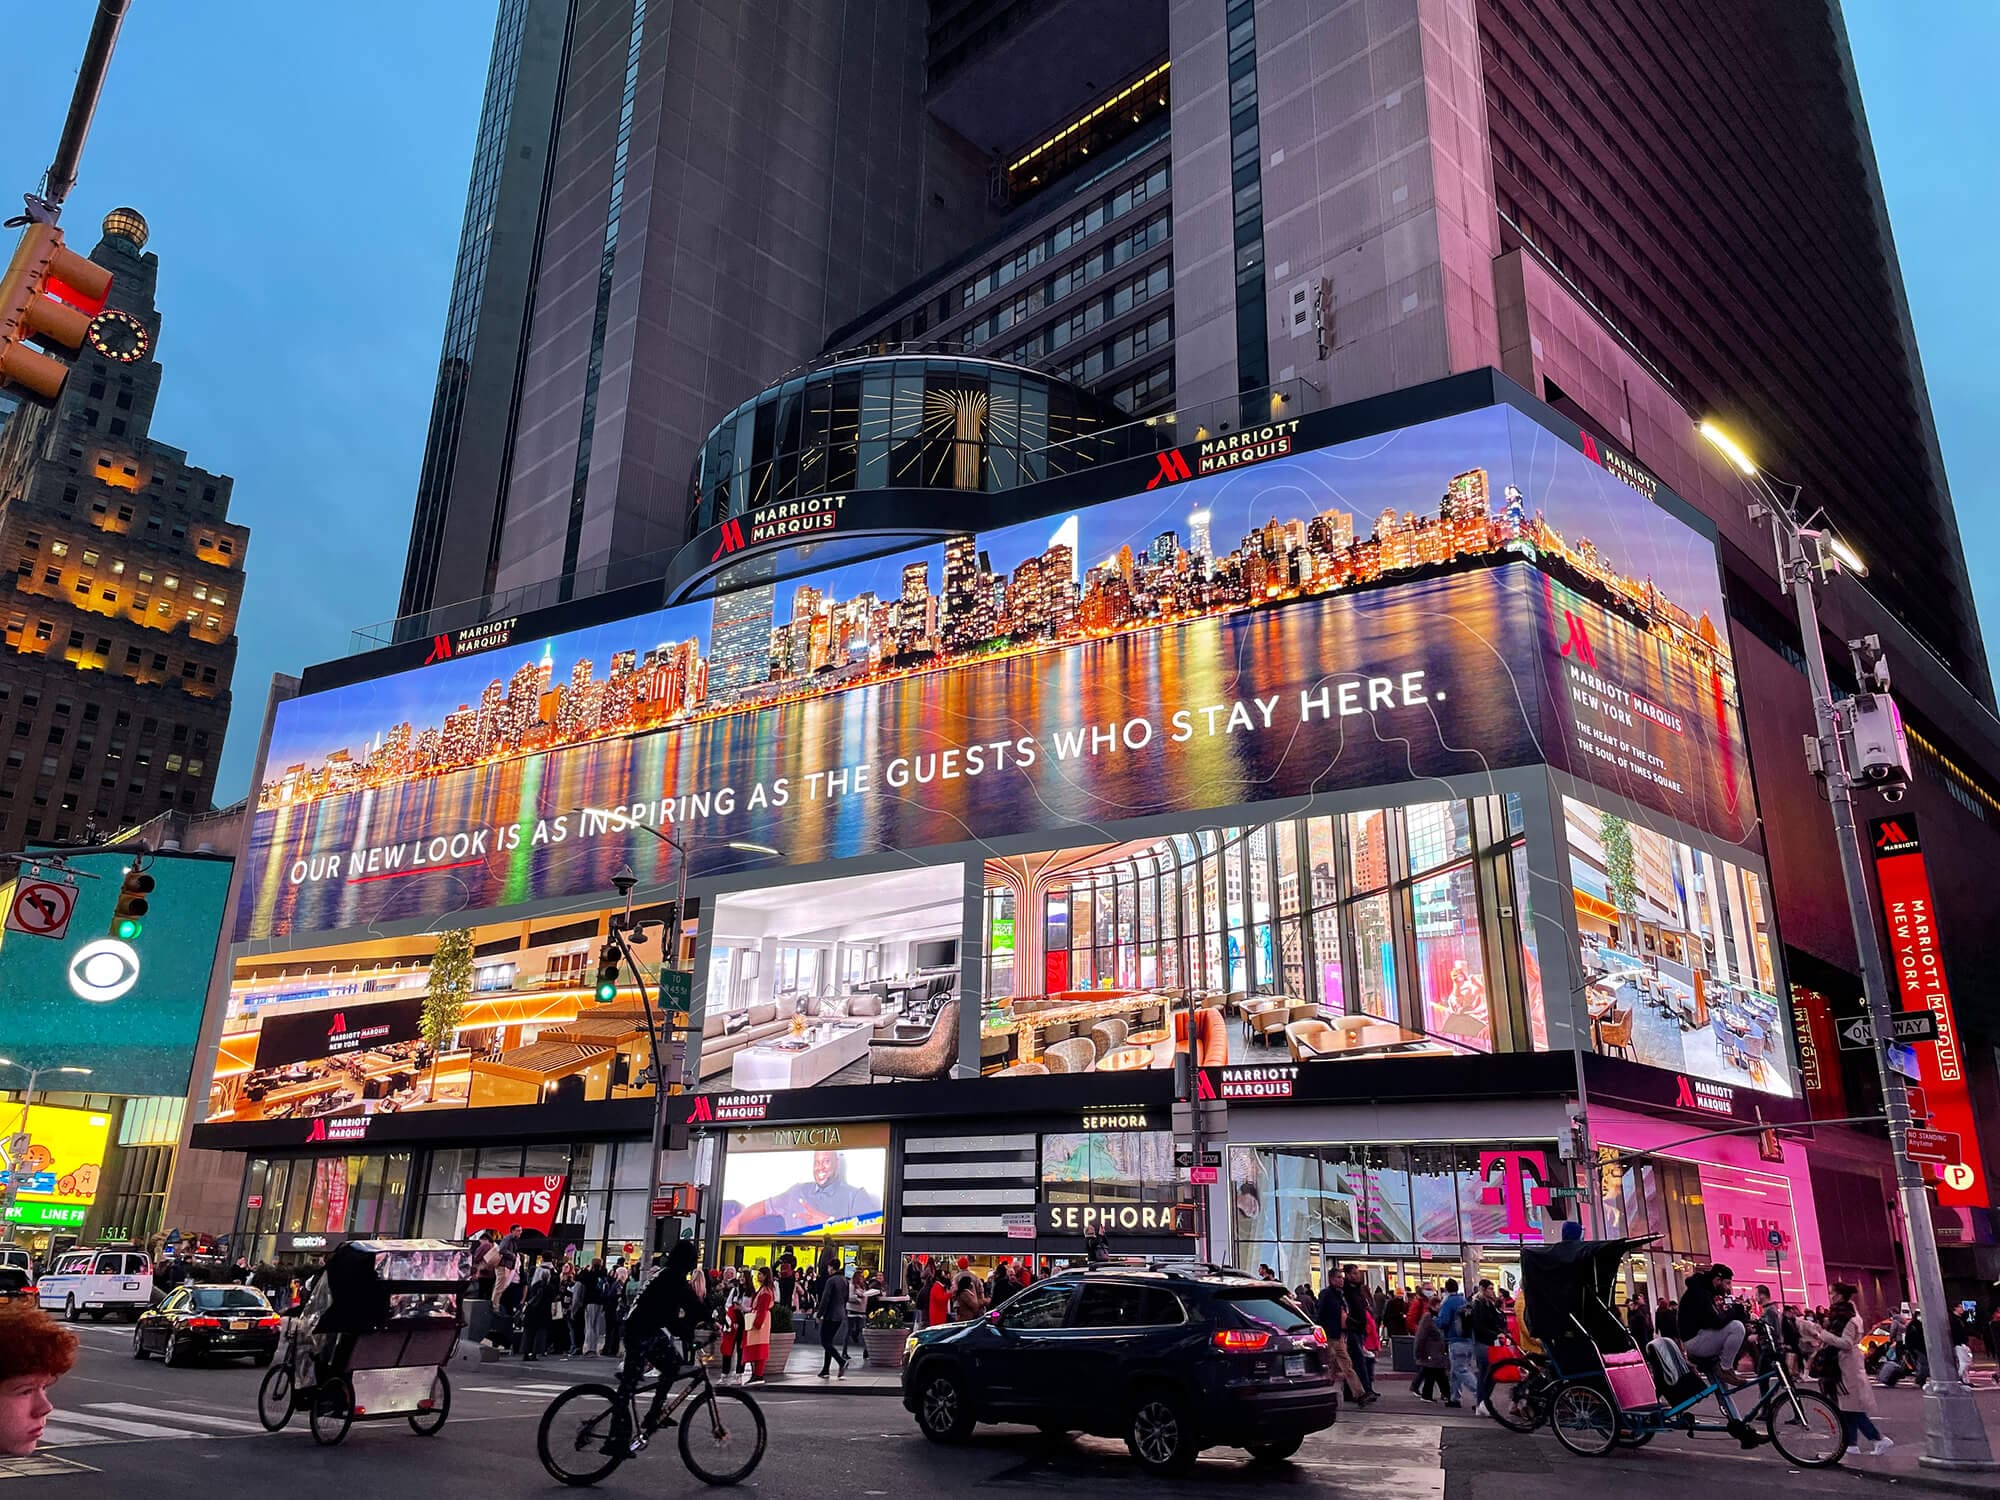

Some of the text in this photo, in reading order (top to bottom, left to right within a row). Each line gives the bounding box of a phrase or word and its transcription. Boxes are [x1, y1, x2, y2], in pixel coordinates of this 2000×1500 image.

[1201, 420, 1299, 455] MARRIOTT
[1202, 440, 1287, 471] MARQUIS
[1606, 450, 1656, 492] MARRIOTT
[755, 496, 846, 525] MARRIOTT
[753, 514, 833, 541] MARQUIS
[459, 618, 518, 640] MARRIOTT
[457, 633, 508, 653] MARQUIS
[1570, 665, 1682, 732] MARRIOTT MARQUIS
[1573, 687, 1633, 728] NEW YORK
[1575, 720, 1667, 770] THE HEART OF THE CITY.
[1577, 738, 1684, 794] THE SOUL OF TIMES SQUARE.
[290, 670, 1447, 885] OUR NEW LOOK IS AS INSPIRING AS THE GUESTS WHO STAY HERE.
[1883, 841, 1919, 851] MARRIOTT
[1892, 902, 1920, 991] NEW YORK
[1911, 899, 1957, 1078] MARRIOTT MARQUIS
[330, 1027, 389, 1042] MARRIOTT MARQUIS
[1852, 1020, 1923, 1039] ON WAY
[328, 1040, 359, 1051] NEW YORK
[1222, 1068, 1299, 1082] MARRIOTT
[1222, 1083, 1290, 1096] MARQUIS
[1695, 1081, 1734, 1100] MARRIOTT
[718, 1094, 773, 1106] MARRIOTT
[1697, 1096, 1732, 1113] MARQUIS
[717, 1107, 765, 1118] MARQUIS
[330, 1117, 372, 1127] MARRIOTT
[1082, 1115, 1148, 1129] SEPHORA
[328, 1128, 366, 1138] MARQUIS
[772, 1127, 841, 1145] INVICTA
[1908, 1130, 1947, 1142] NO STANDING
[1909, 1139, 1934, 1148] Anytime
[1952, 1168, 1967, 1186] P
[41, 1208, 69, 1220] LINE
[1050, 1207, 1171, 1229] SEPHORA
[99, 1226, 128, 1240] 1515
